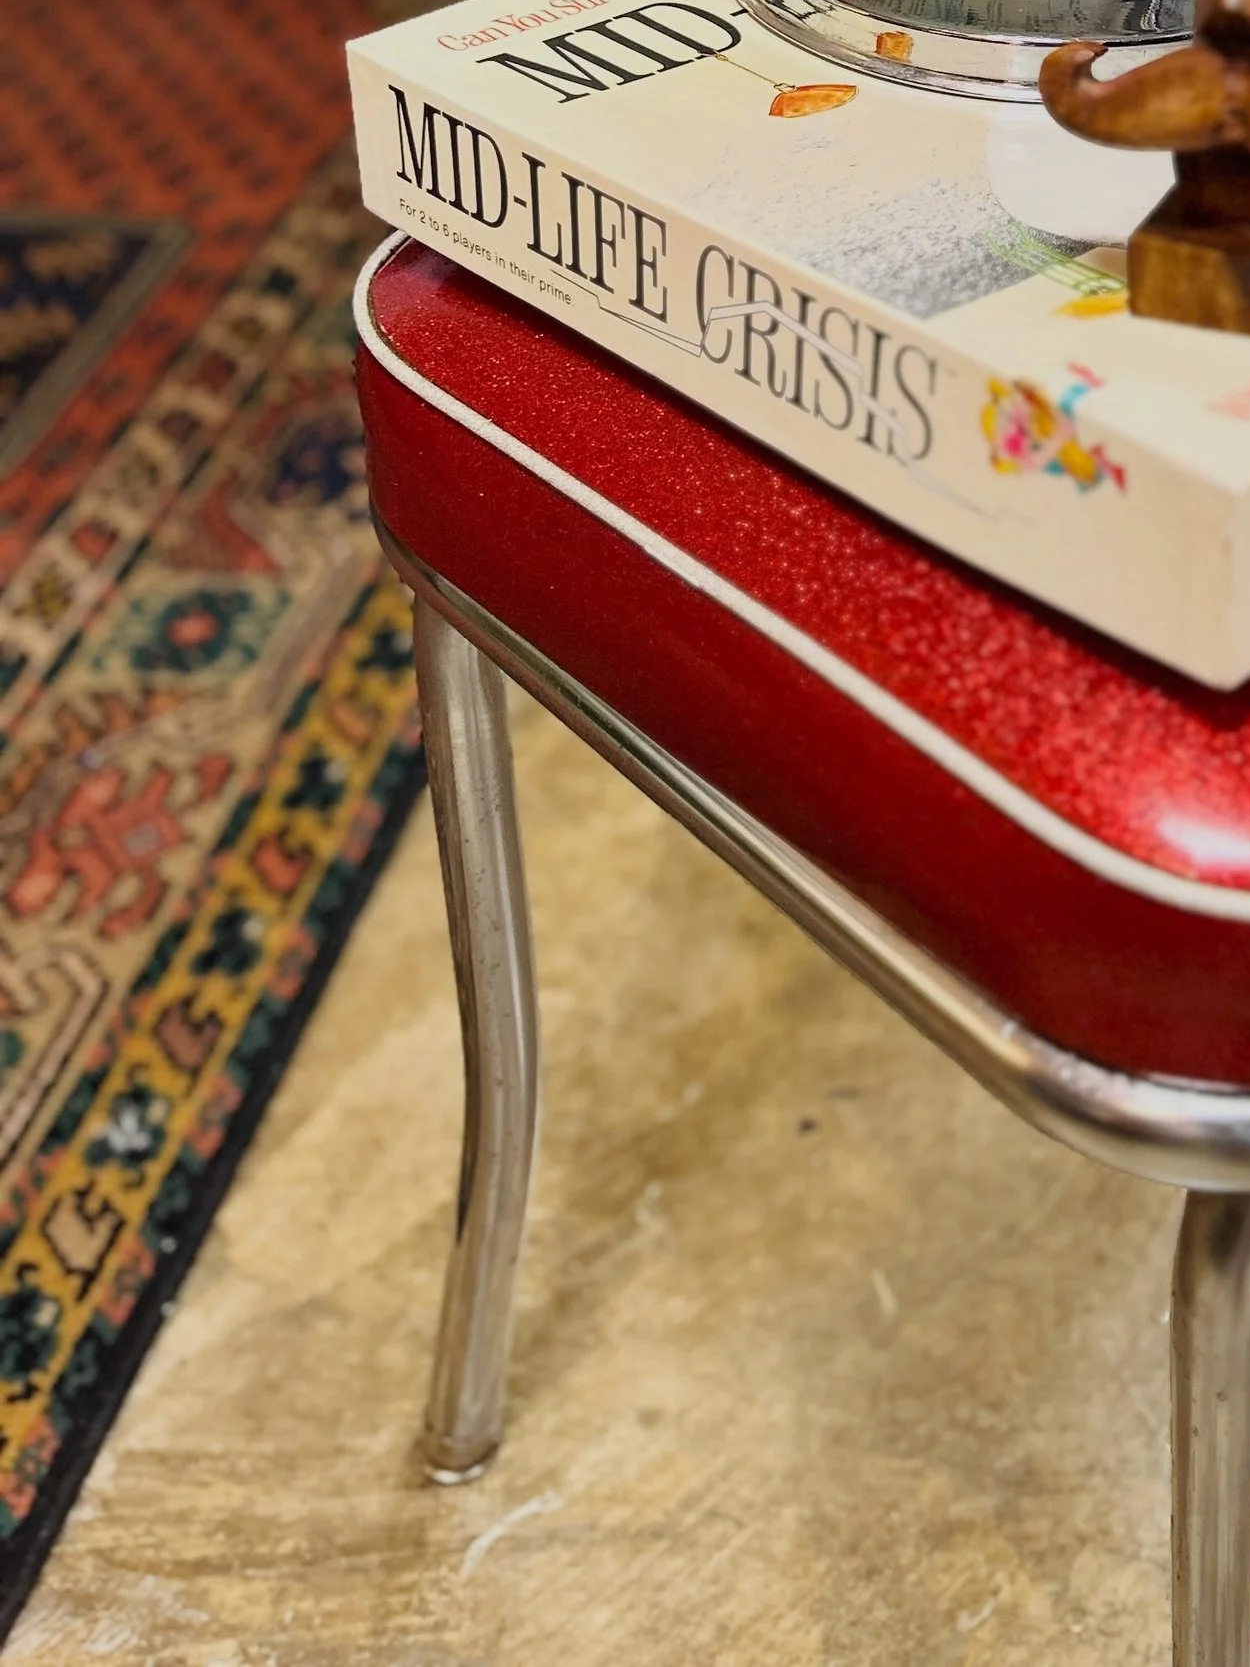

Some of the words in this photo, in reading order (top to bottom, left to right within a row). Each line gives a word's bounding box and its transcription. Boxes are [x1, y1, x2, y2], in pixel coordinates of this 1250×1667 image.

[437, 21, 504, 51] Can
[493, 4, 559, 36] You
[388, 84, 669, 323] MID-LIFE
[695, 244, 939, 462] CRISIS
[399, 198, 417, 217] For
[419, 210, 427, 224] 2
[429, 216, 440, 232] to
[442, 223, 450, 238] 6
[453, 231, 492, 262] players
[495, 252, 506, 270] in
[509, 261, 536, 282] their
[539, 278, 575, 308] prime.
